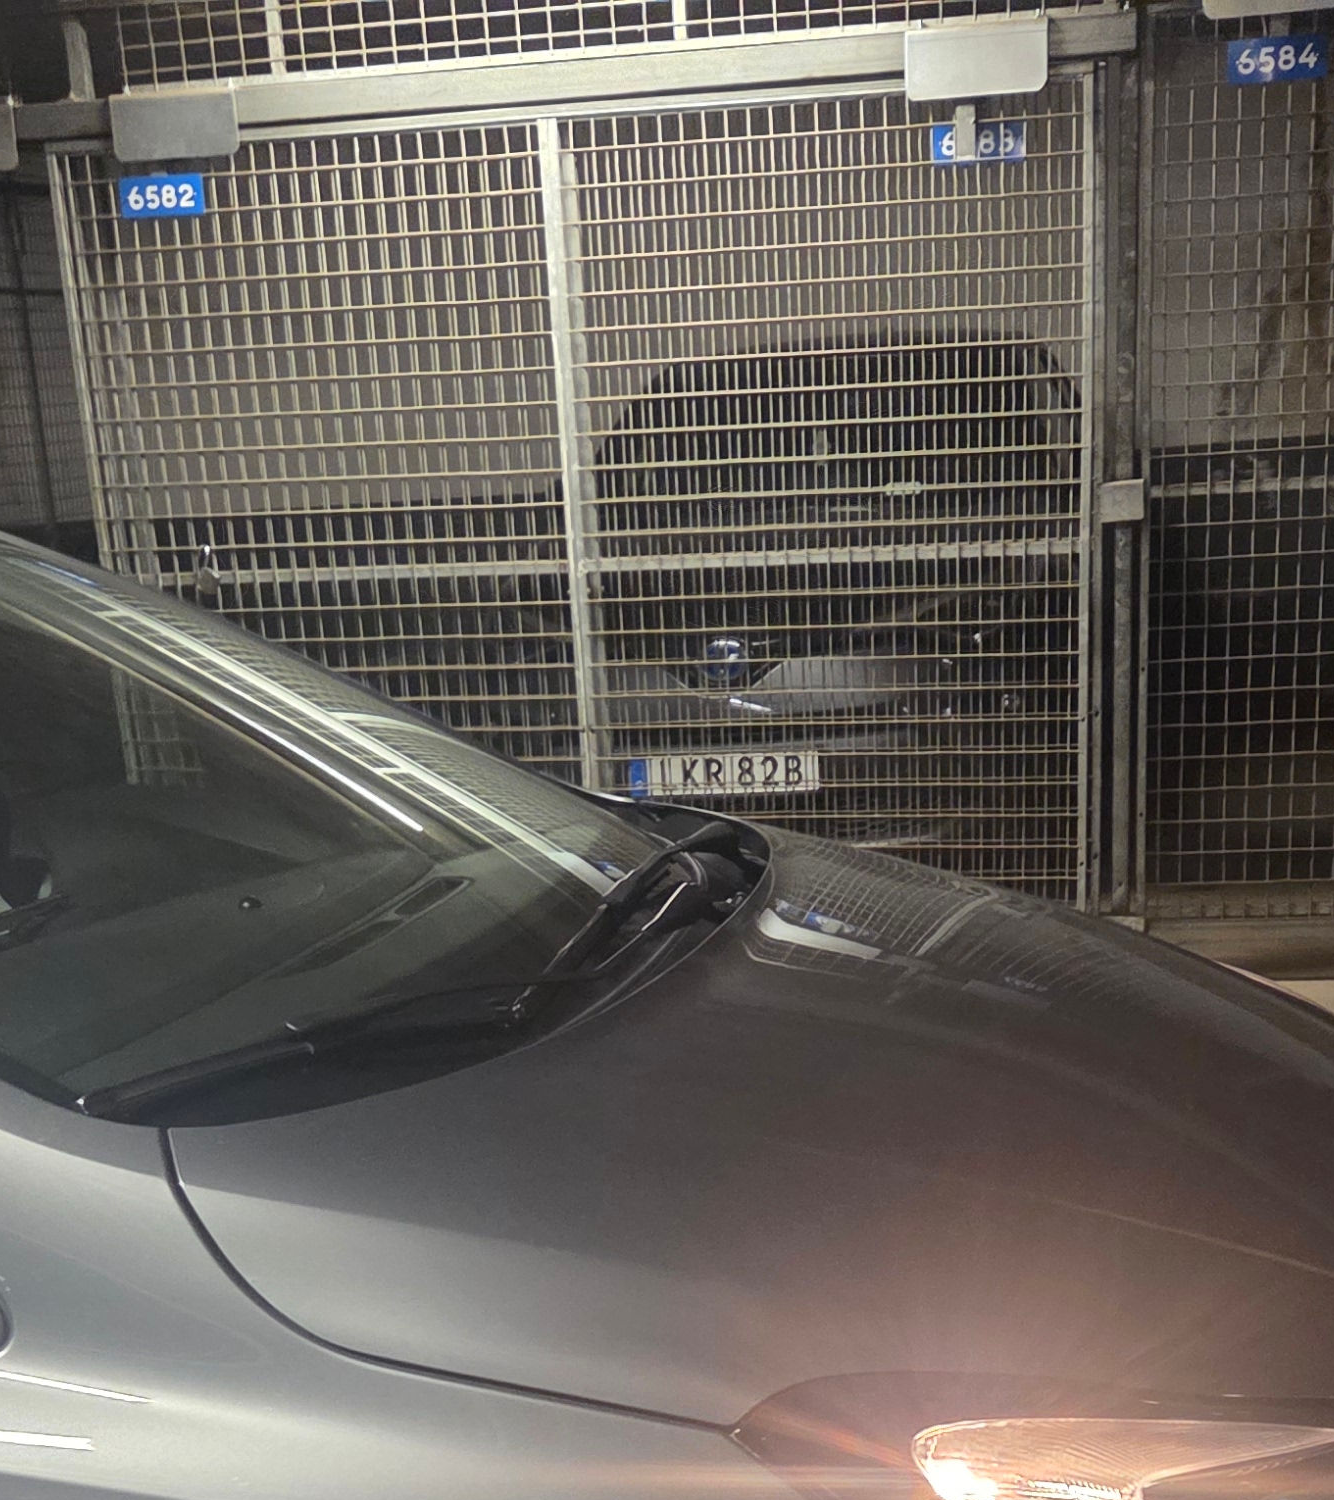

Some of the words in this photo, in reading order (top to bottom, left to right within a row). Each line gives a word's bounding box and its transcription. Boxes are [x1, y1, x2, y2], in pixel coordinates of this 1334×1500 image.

[1236, 43, 1318, 75] 6584
[940, 129, 1015, 156] 683
[128, 184, 196, 210] 6582
[737, 754, 803, 787] 82B
